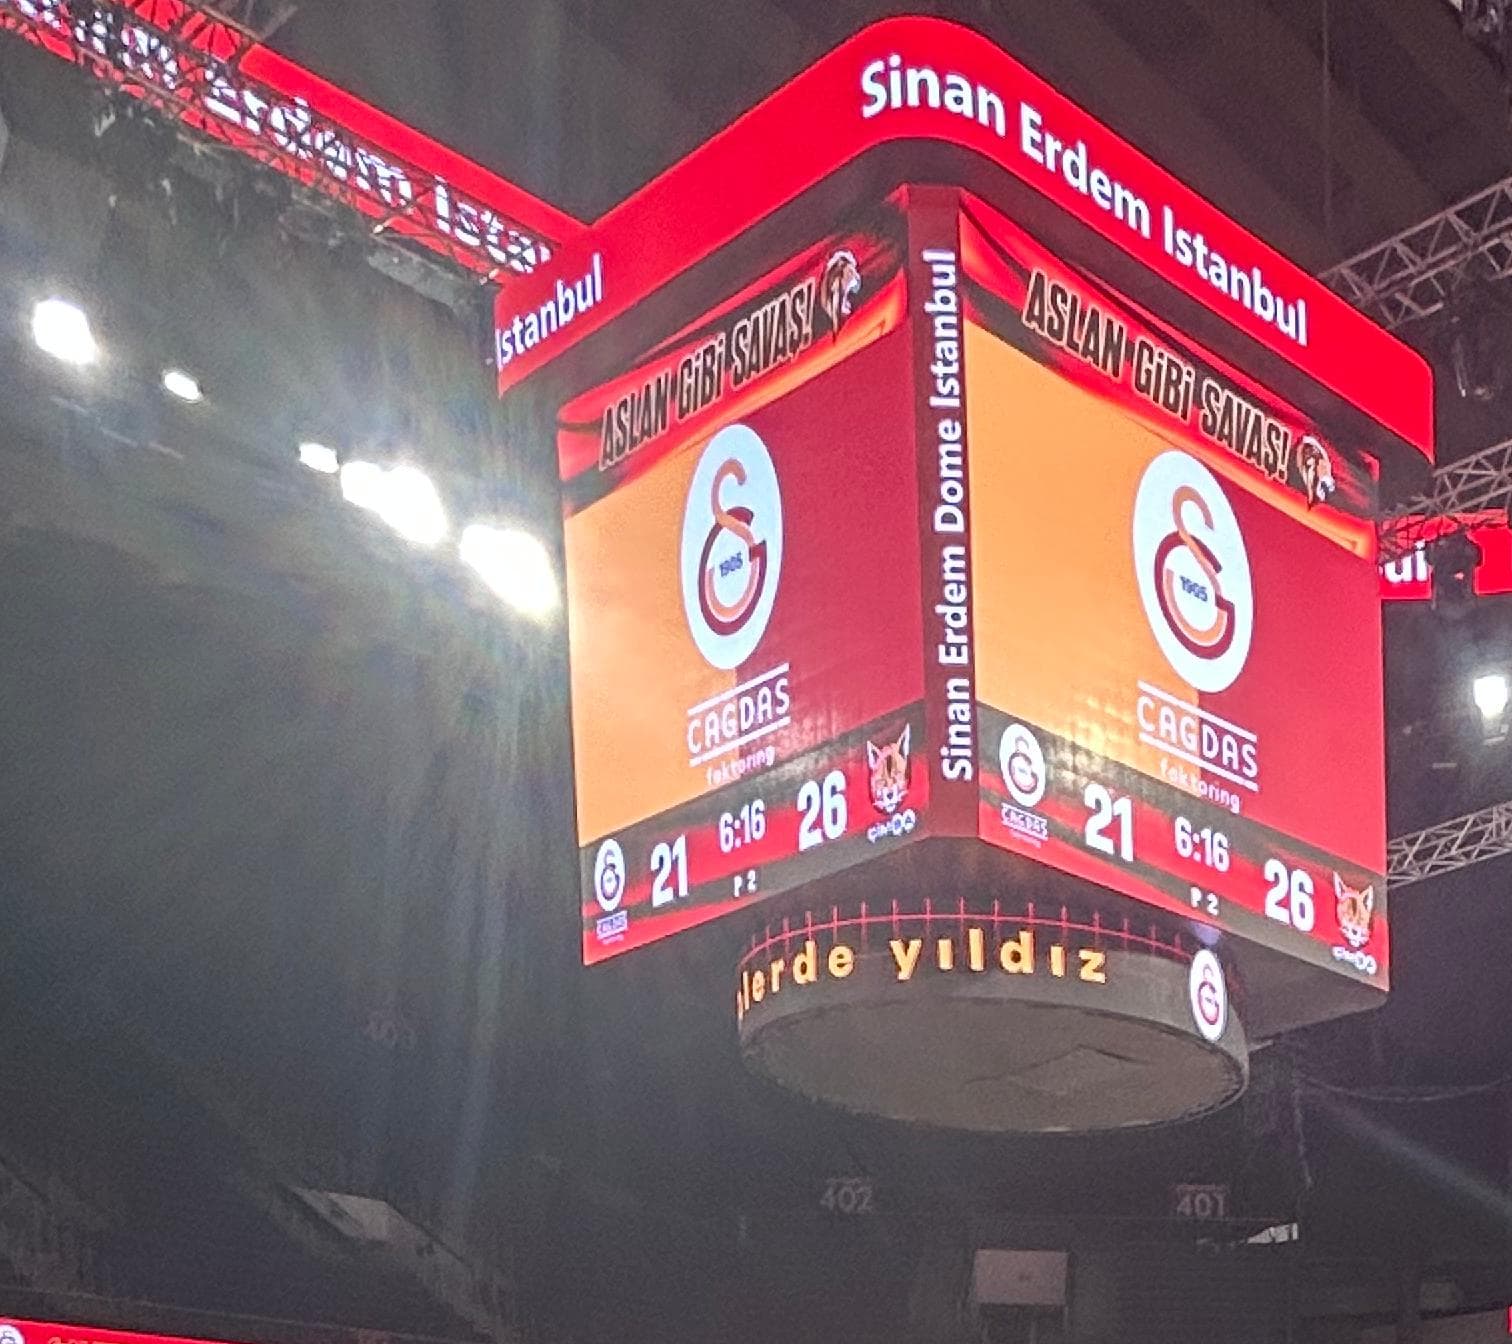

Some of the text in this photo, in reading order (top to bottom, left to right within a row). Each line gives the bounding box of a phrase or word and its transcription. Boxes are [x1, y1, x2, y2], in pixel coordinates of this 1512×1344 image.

[860, 54, 1308, 346] Sinan Erdem Istanbul
[1022, 266, 1126, 380] ASLAN
[598, 361, 670, 470] ASLAN
[922, 247, 972, 782] Sinan Erdem Dome Istanbul
[688, 679, 790, 754] CAGDAS
[1136, 696, 1259, 778] CAGDAS
[651, 836, 690, 908] 21
[719, 799, 766, 853] 6:16
[797, 771, 848, 852] 26
[734, 875, 757, 897] P 2
[1084, 783, 1315, 932] 21 6:16 26
[1190, 887, 1219, 916] P 2
[737, 927, 1108, 1010] lerde yıldız
